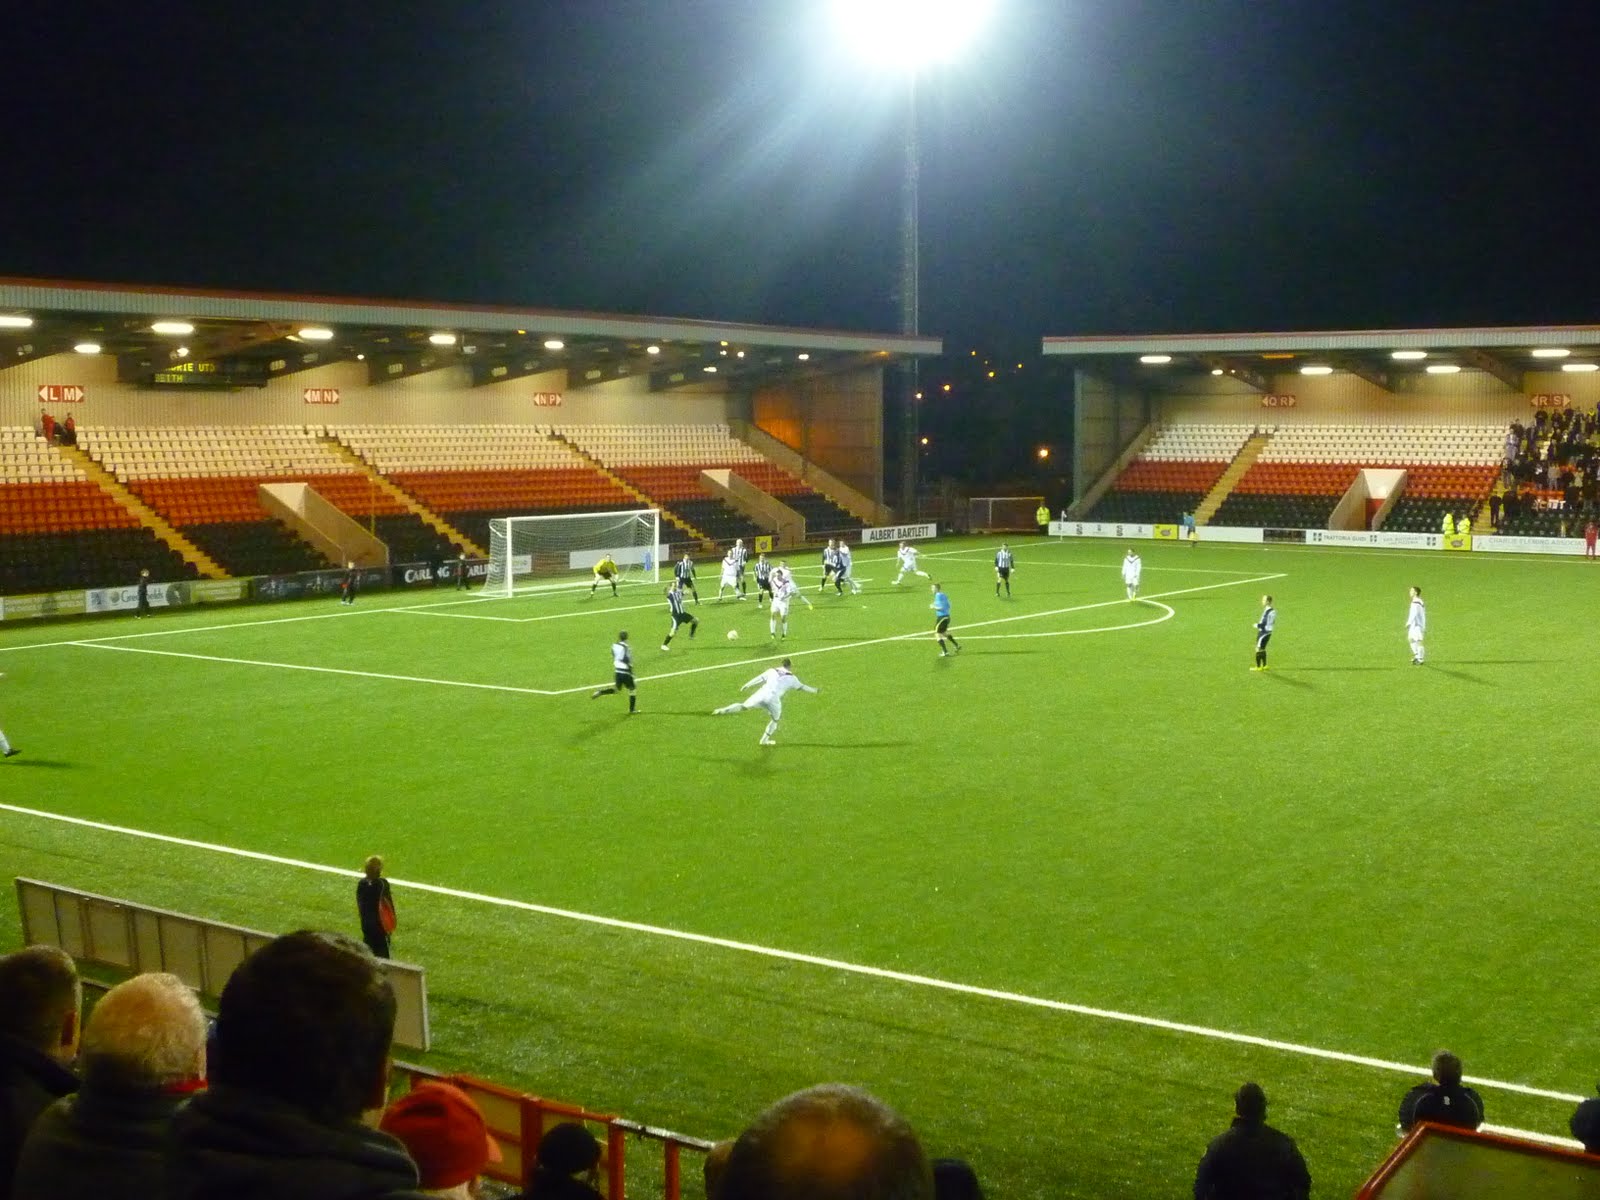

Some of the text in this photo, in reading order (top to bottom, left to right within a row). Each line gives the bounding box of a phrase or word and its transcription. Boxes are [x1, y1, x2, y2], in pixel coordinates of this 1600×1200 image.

[49, 387, 75, 401] L M
[311, 390, 332, 402] M N
[540, 394, 556, 405] N P
[1269, 396, 1288, 406] Q R
[1540, 395, 1561, 406] R S
[870, 526, 929, 541] ALBERT BARTLETT
[404, 566, 450, 583] CARLNG
